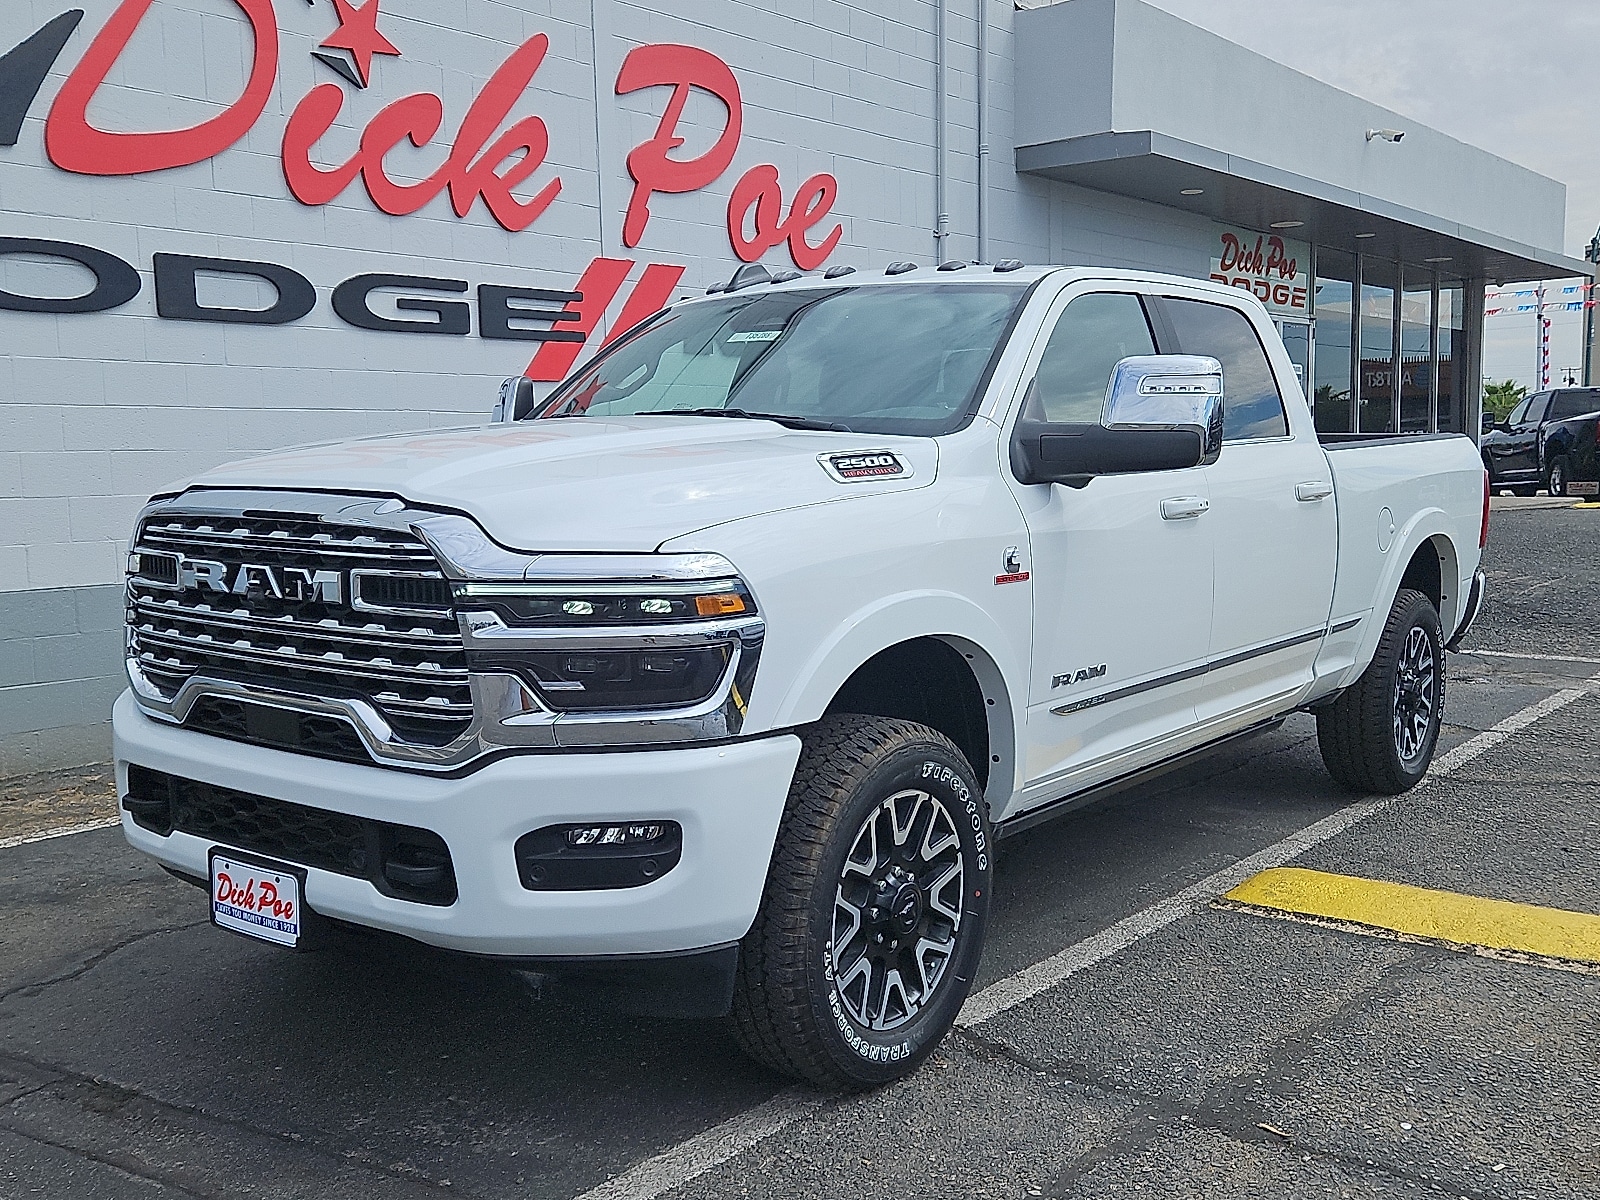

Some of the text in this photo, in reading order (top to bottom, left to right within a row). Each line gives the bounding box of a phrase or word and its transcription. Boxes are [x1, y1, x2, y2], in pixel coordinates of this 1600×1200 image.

[45, 0, 843, 271] Dick Poe
[1221, 233, 1298, 280] Dick Poe
[836, 455, 894, 469] 2500
[181, 559, 343, 605] RAM
[1050, 663, 1107, 689] RAM
[217, 872, 295, 920] Dick Poe
[262, 916, 278, 930] SINCE
[828, 989, 910, 1061] TRANSFORCE
